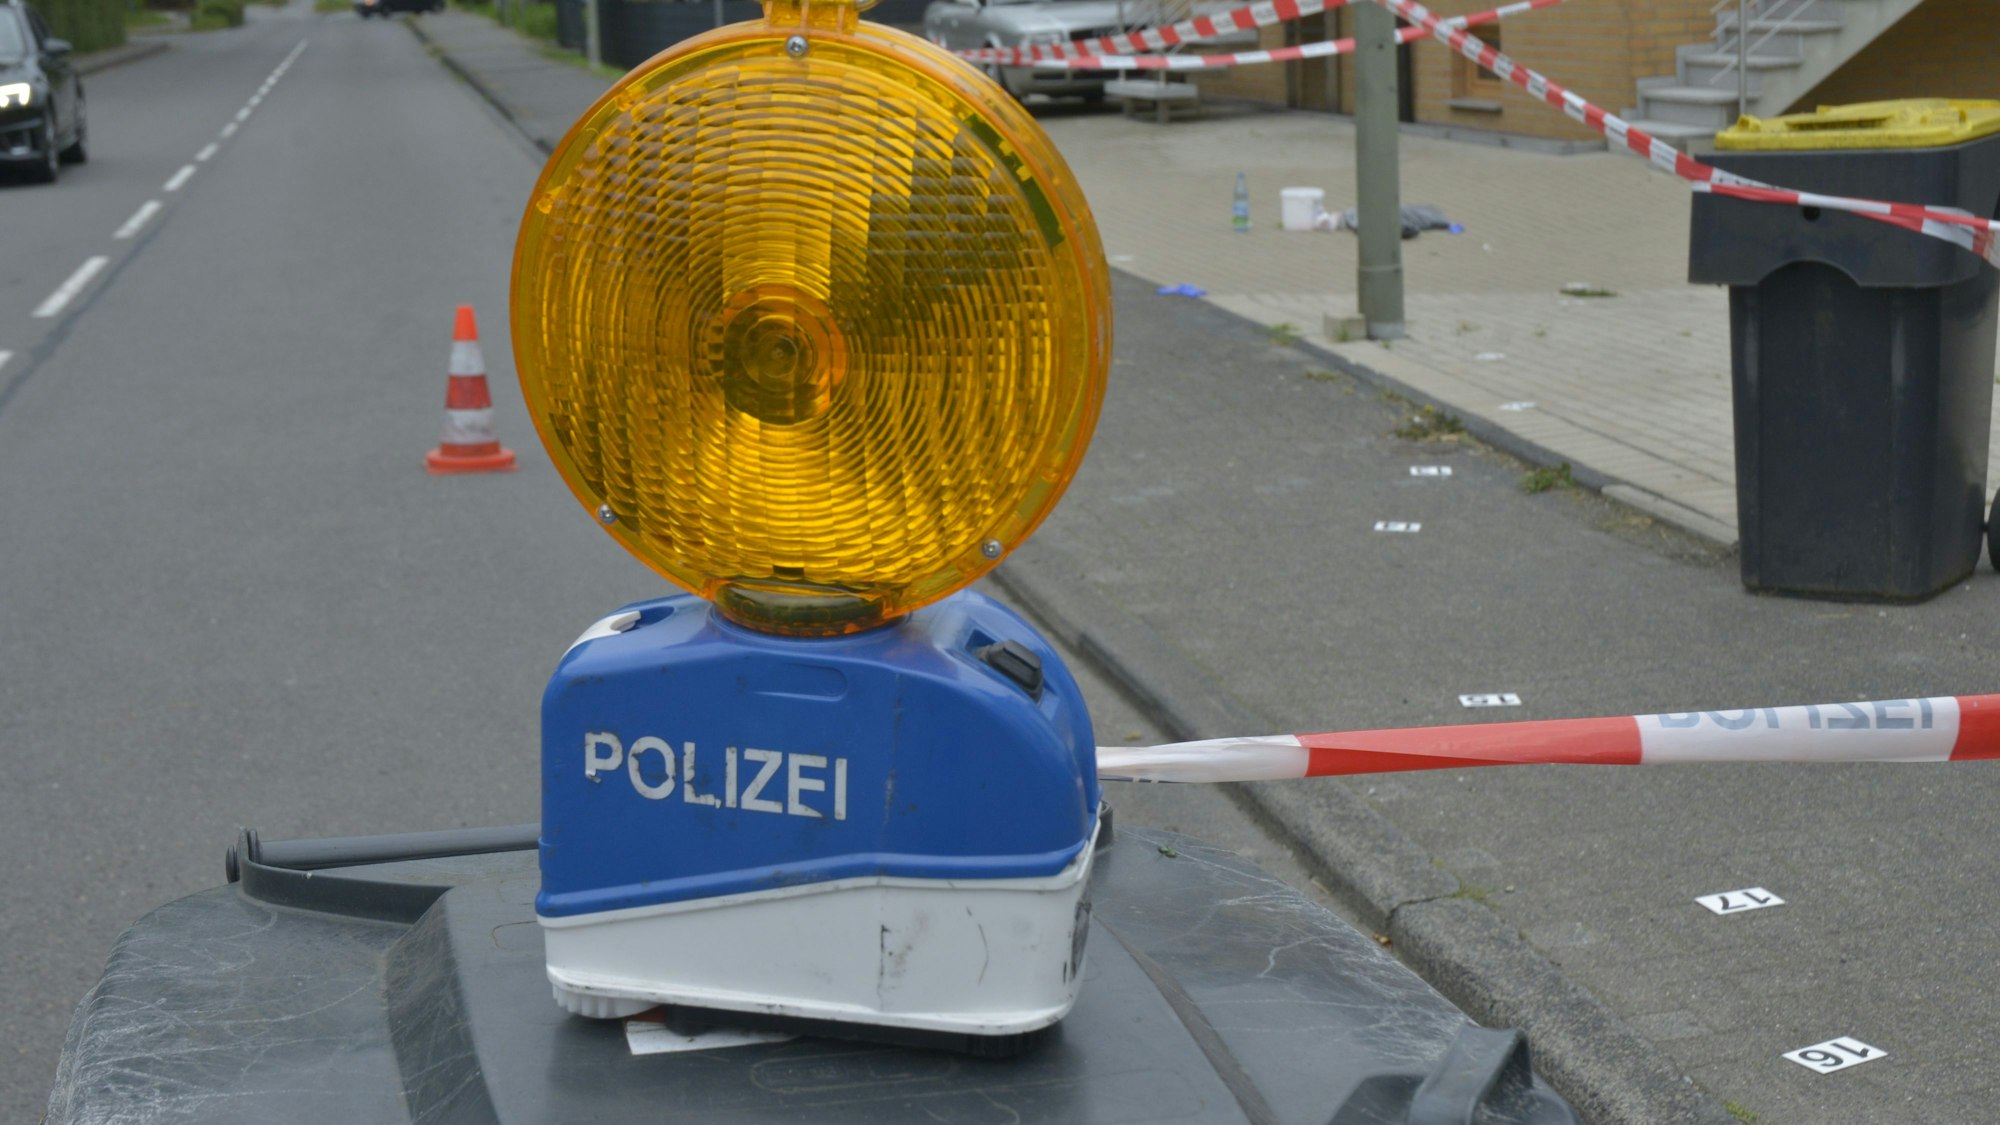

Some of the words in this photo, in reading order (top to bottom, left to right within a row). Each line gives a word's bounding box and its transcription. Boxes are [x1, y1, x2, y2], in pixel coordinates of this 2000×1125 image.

[586, 732, 847, 820] POLIZEI
[1719, 891, 1771, 910] 17
[1798, 1042, 1870, 1067] 16
